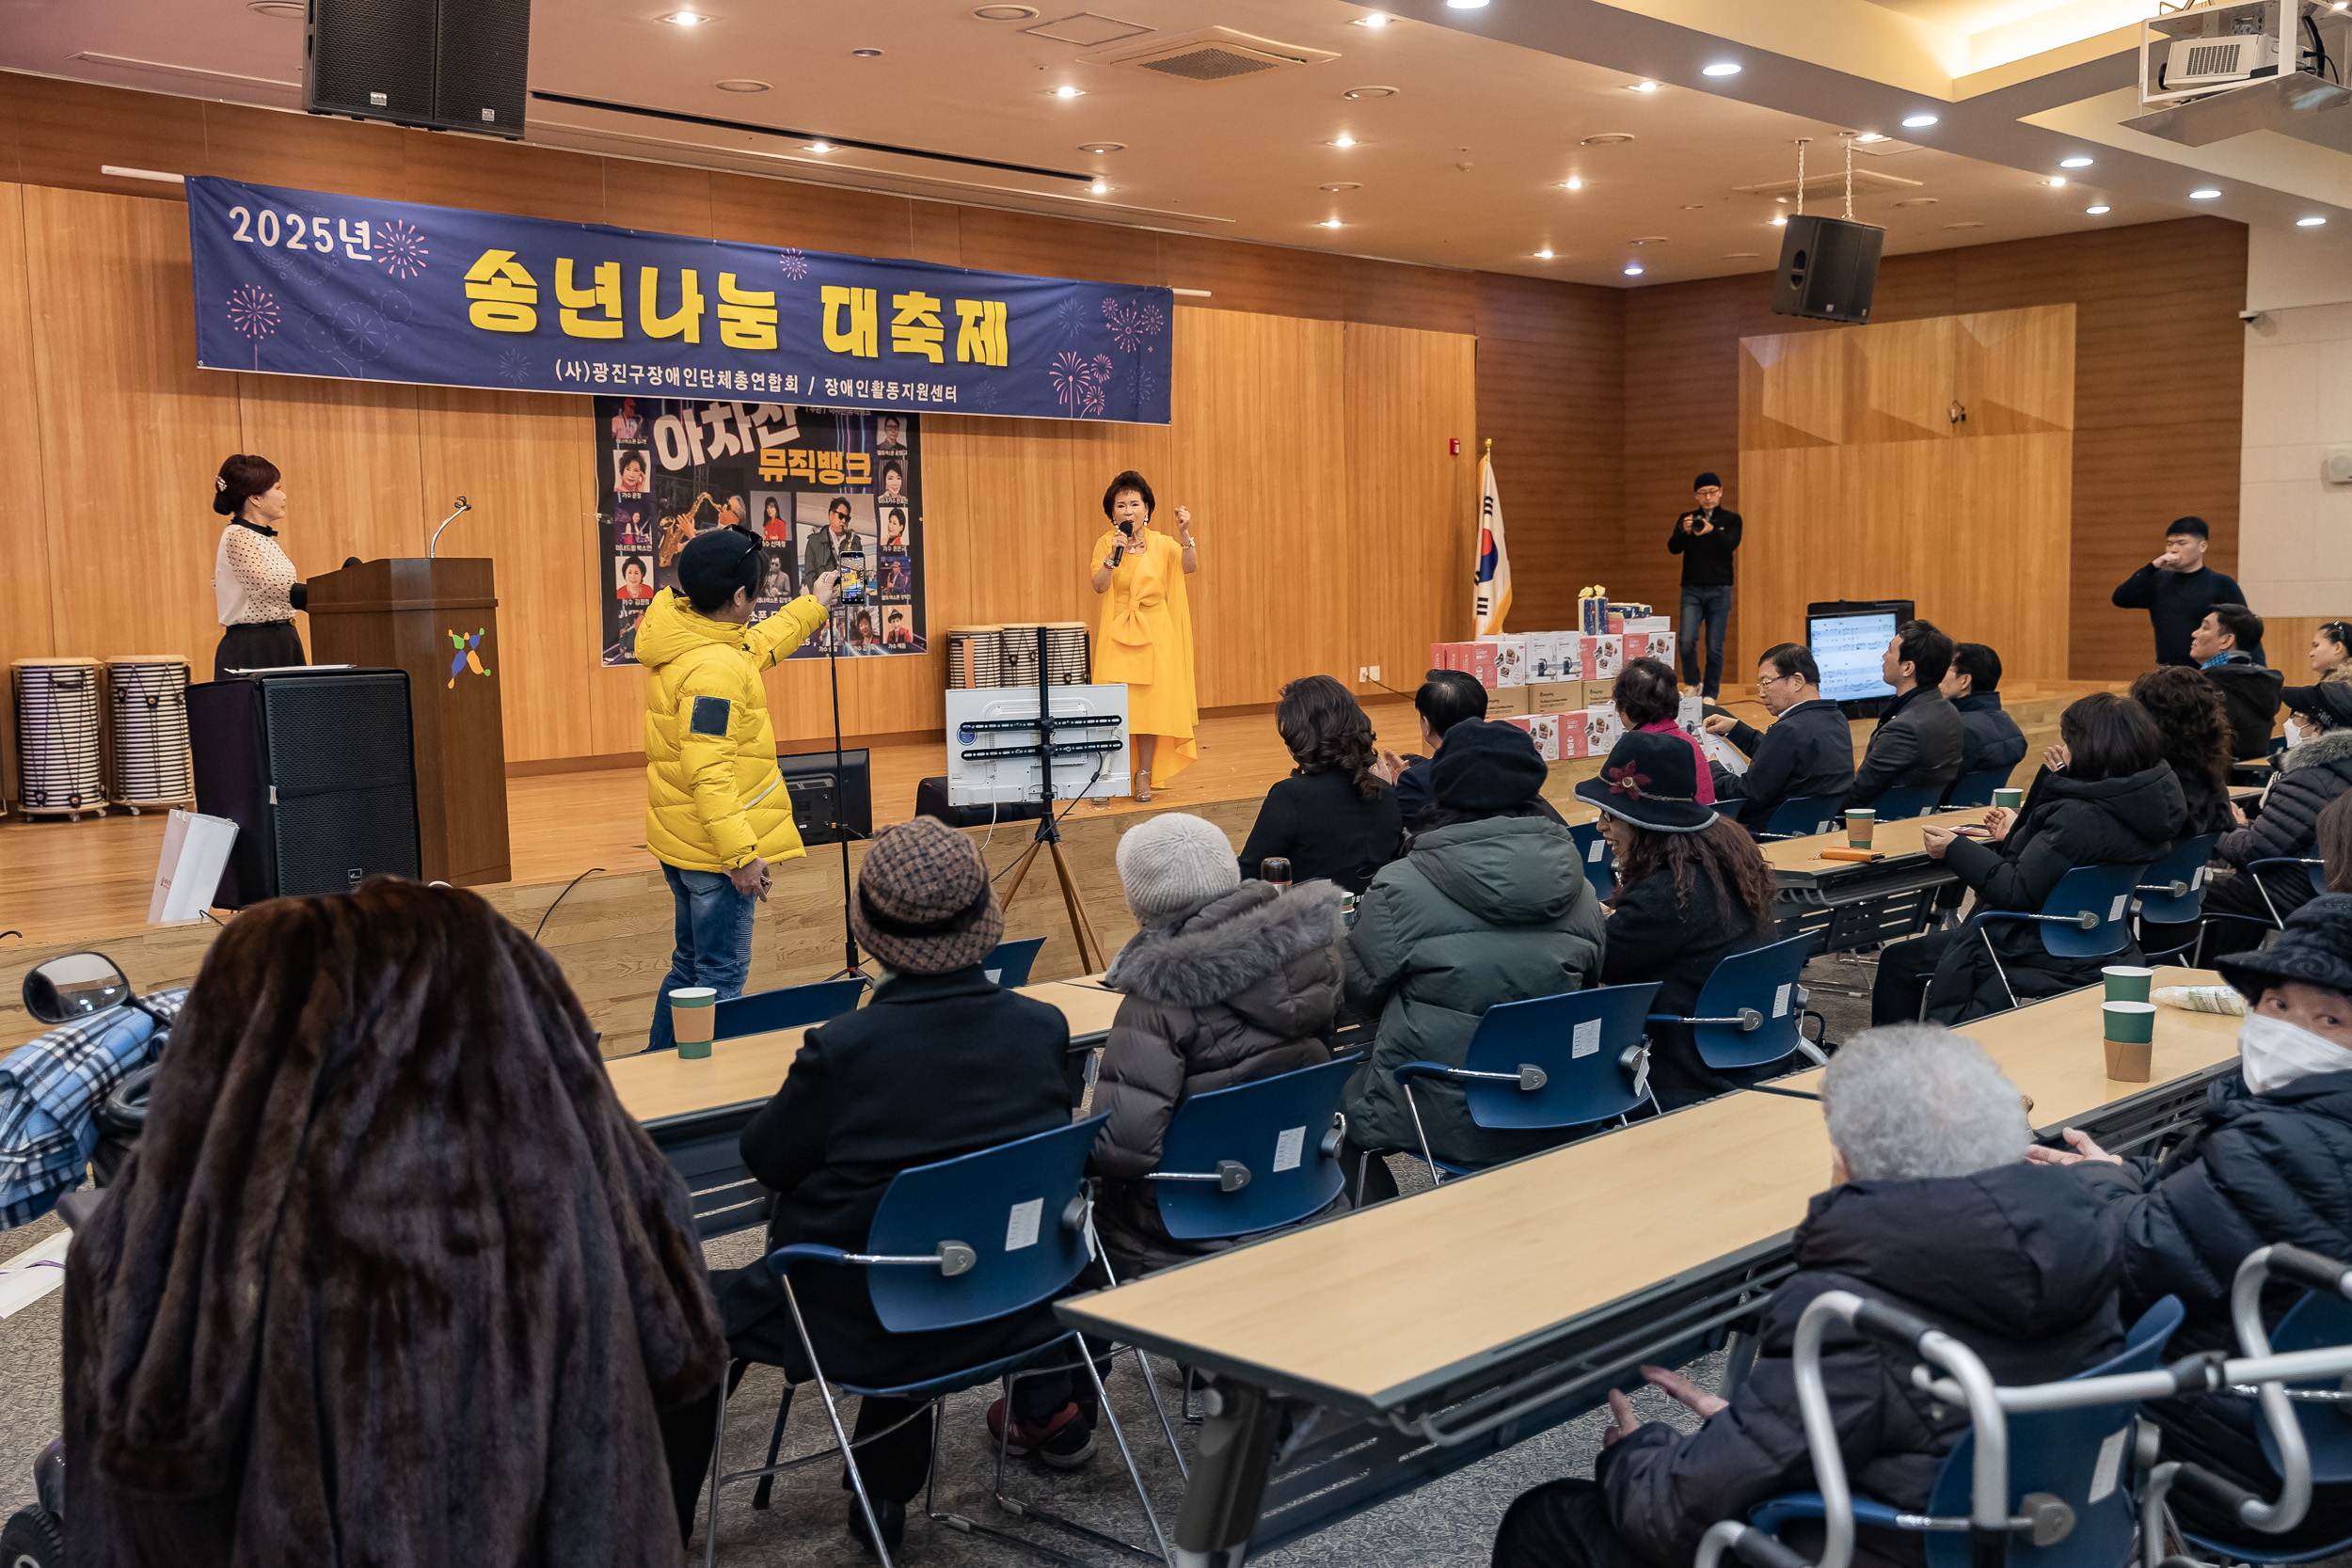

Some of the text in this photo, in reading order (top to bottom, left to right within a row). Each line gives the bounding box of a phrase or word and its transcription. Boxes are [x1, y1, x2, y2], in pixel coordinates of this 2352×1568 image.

[229, 206, 373, 261] 2025년
[463, 249, 1009, 367] 송년나눔 대축제
[555, 358, 800, 394] (사)광진구장애인단체총연합회
[824, 377, 958, 404] 장애인활동지원센터
[653, 404, 801, 471] 아차산
[758, 448, 873, 486] 뮤직뱅크
